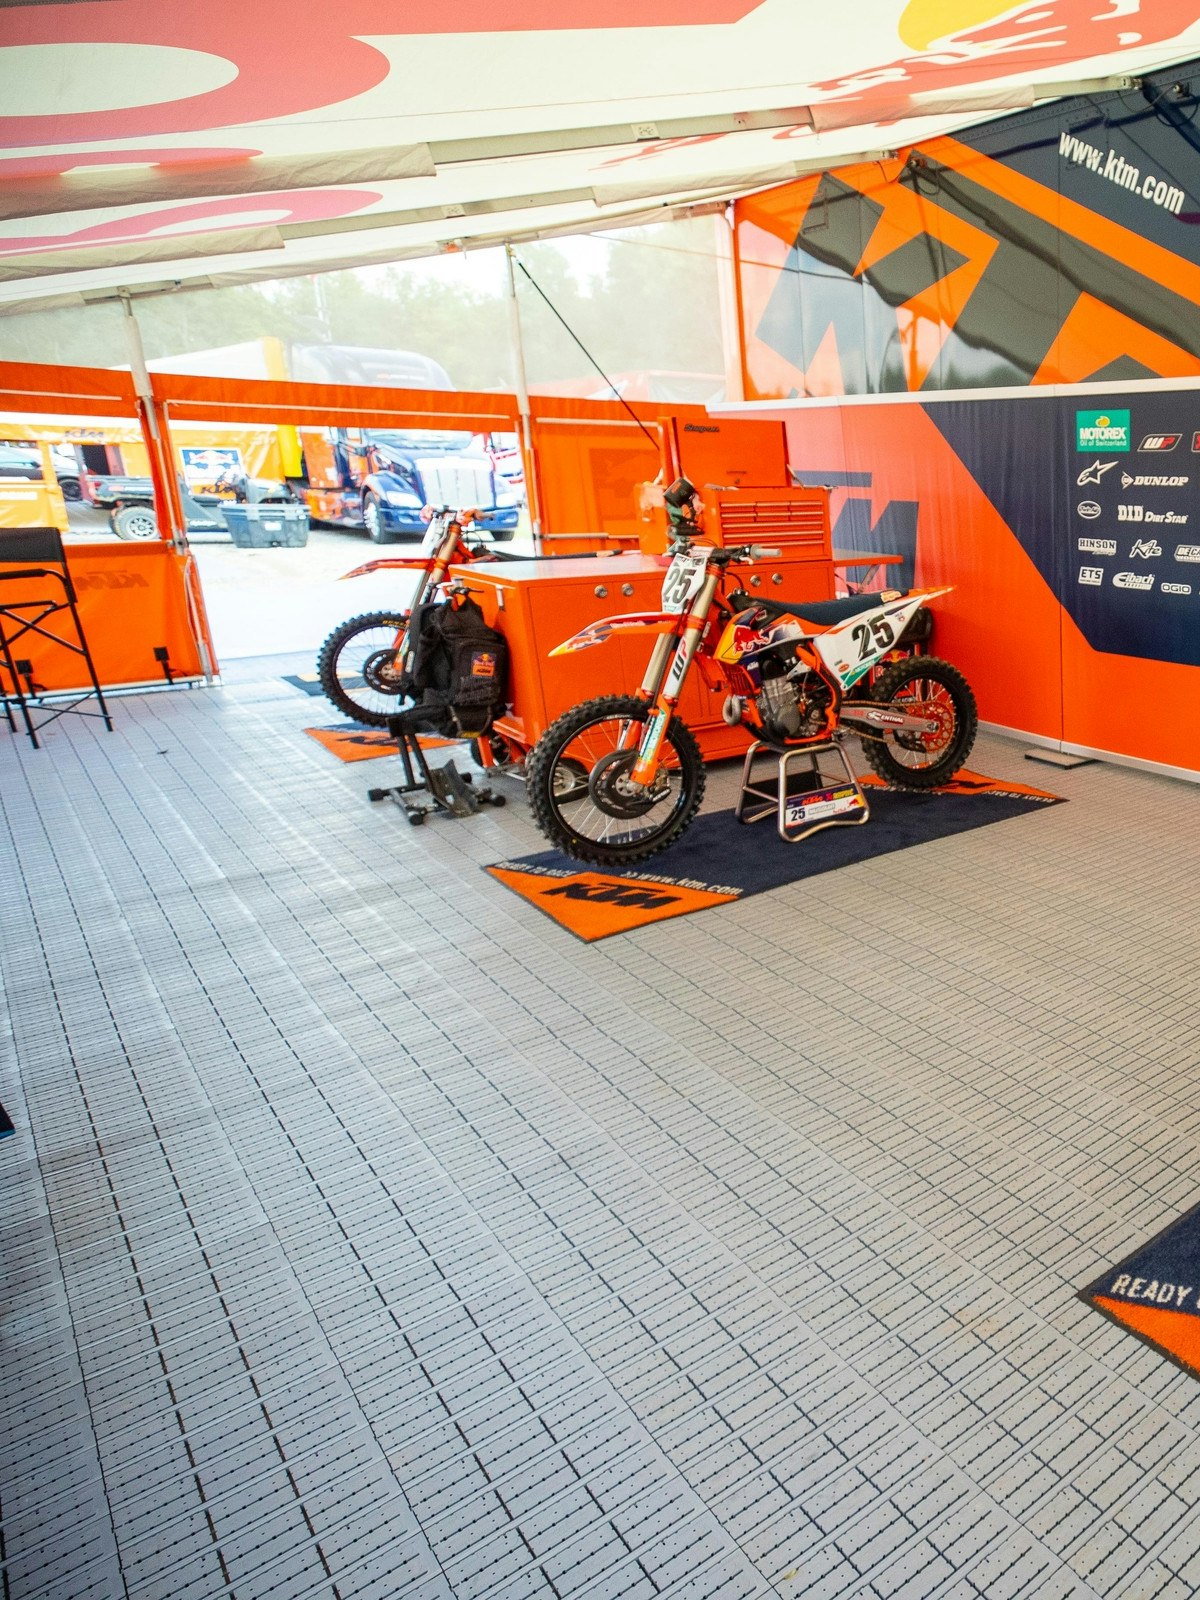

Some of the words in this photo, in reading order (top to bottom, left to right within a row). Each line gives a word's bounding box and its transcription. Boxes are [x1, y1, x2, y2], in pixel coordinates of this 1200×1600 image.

[1059, 132, 1185, 215] www.ktm.com
[1080, 427, 1127, 439] MOTOREX
[1143, 437, 1175, 449] WP
[1133, 475, 1189, 486] DUNLOP
[1079, 540, 1116, 549] HINSON
[1129, 539, 1162, 558] Kite
[1081, 569, 1101, 579] ETS
[1114, 572, 1155, 585] Eibach
[663, 568, 697, 604] 25
[1162, 584, 1191, 593] OGIO
[851, 613, 895, 661] 25
[791, 808, 806, 821] 25
[638, 872, 744, 896] www.ktm.com
[540, 883, 683, 909] KTM
[1110, 1274, 1192, 1308] READY
